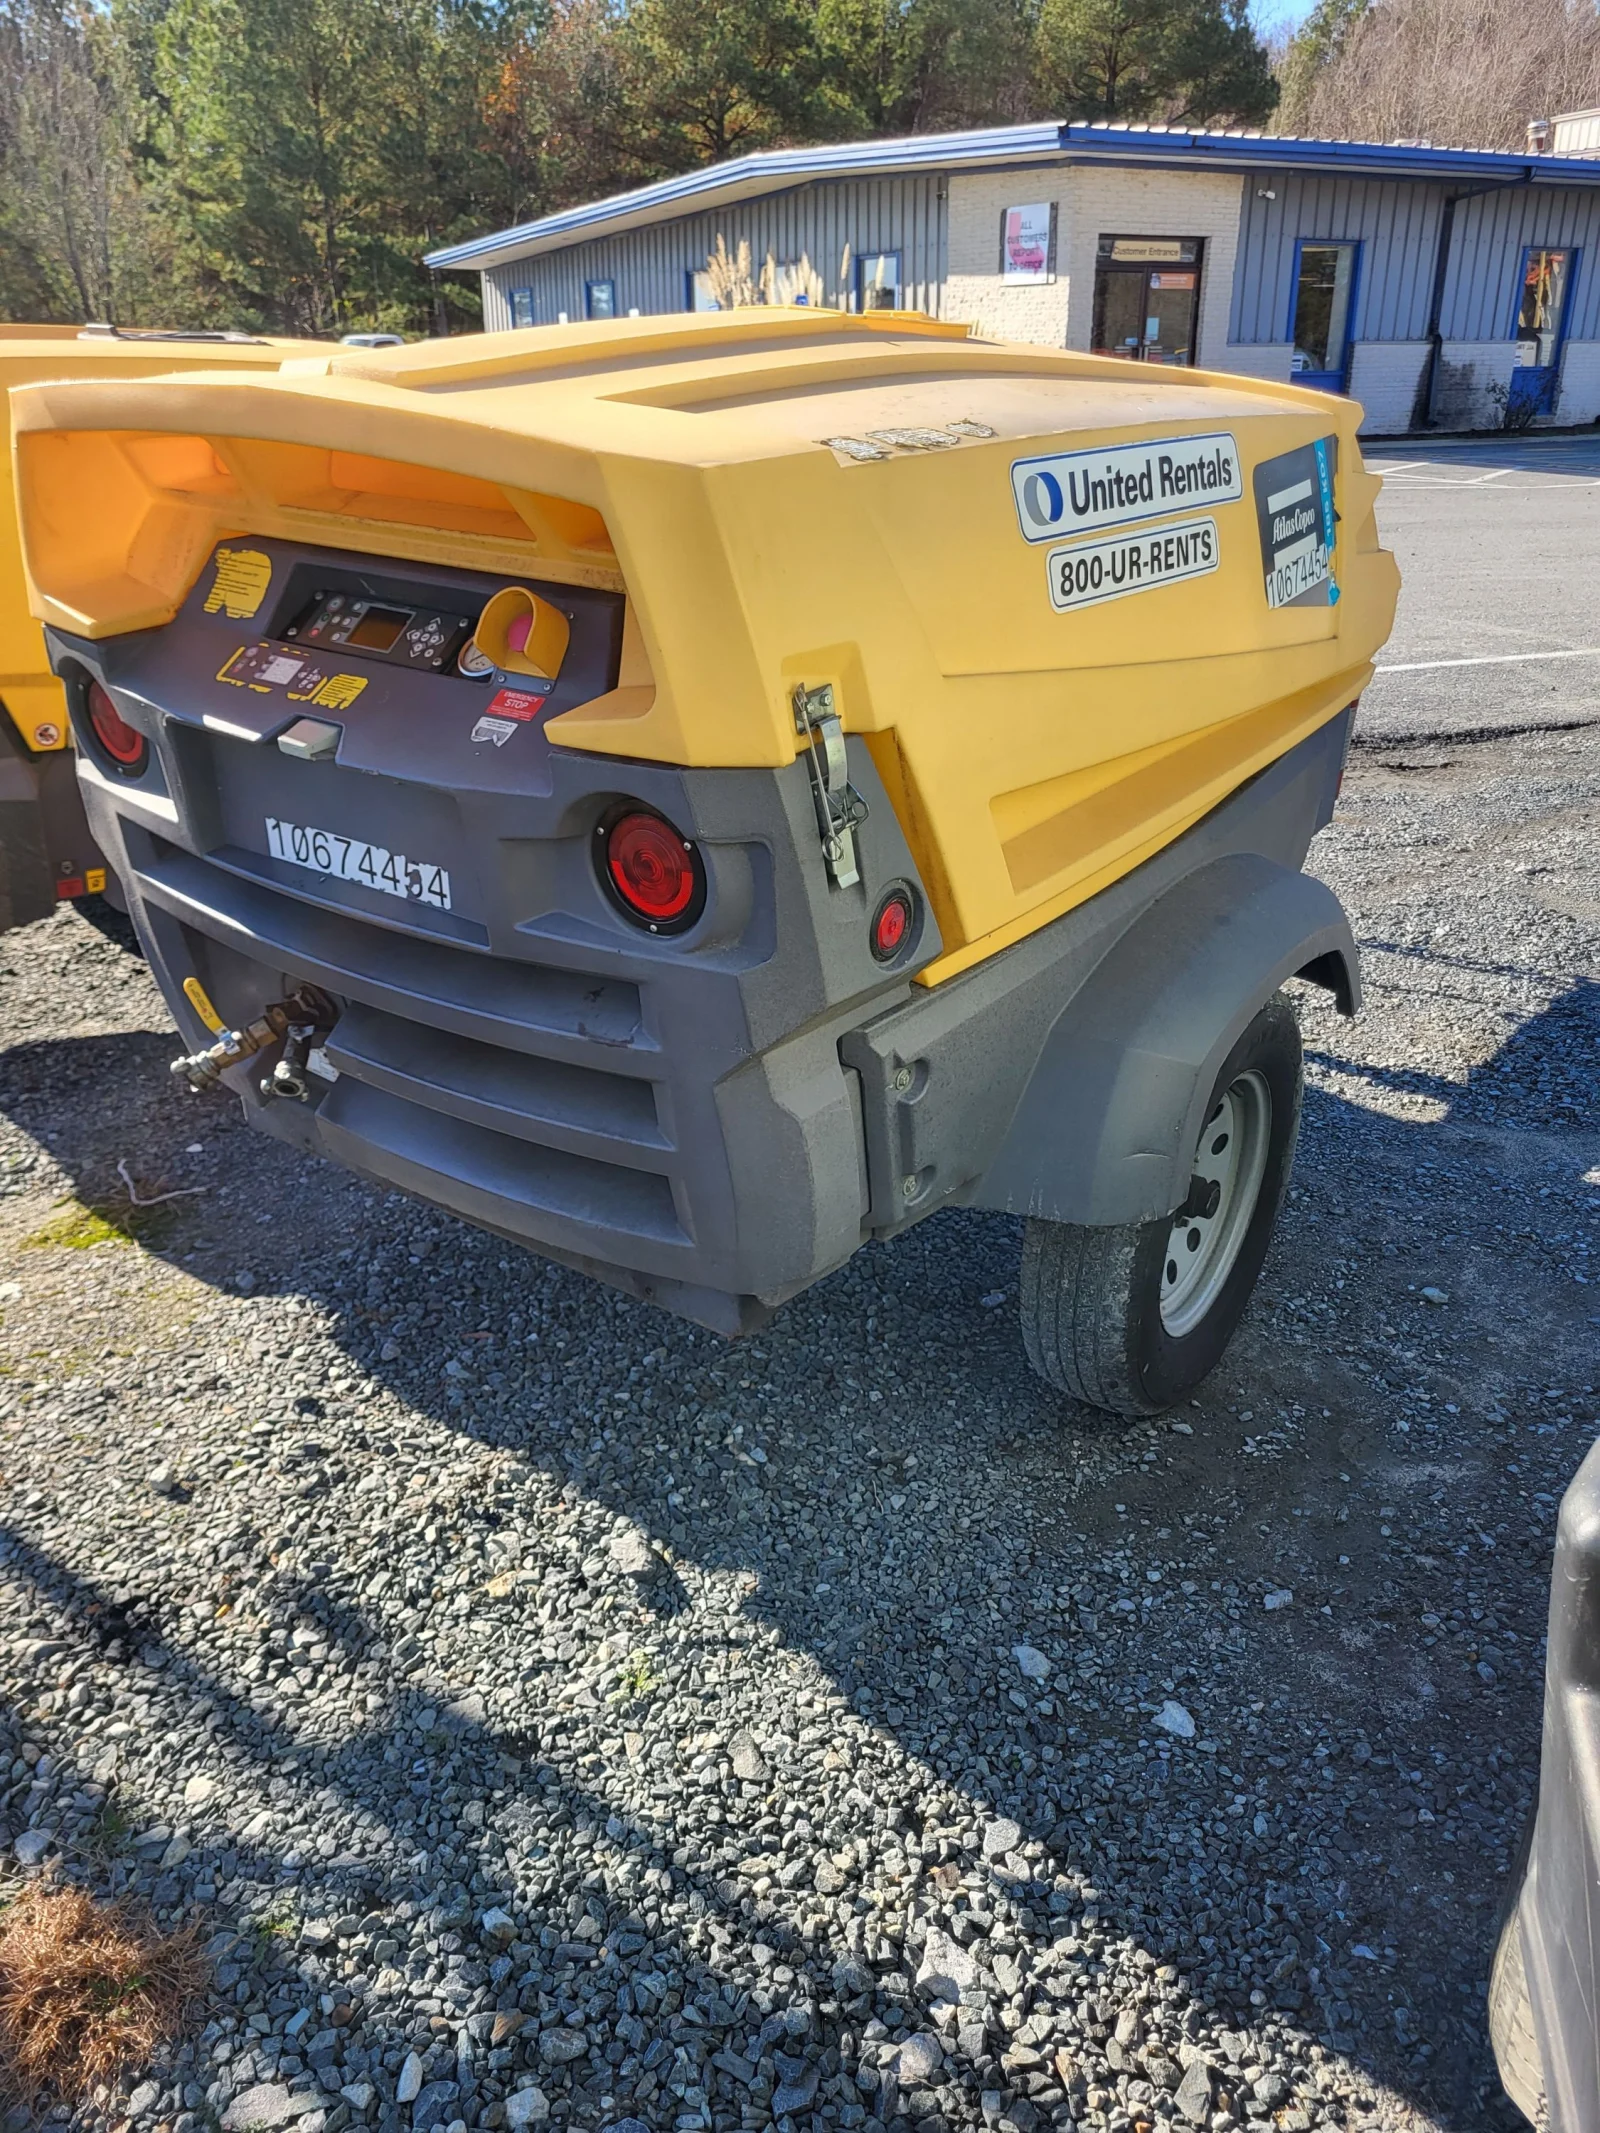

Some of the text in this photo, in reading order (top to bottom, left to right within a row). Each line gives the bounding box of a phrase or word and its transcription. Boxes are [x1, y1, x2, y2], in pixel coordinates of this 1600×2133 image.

[1020, 220, 1033, 230] ALL
[1007, 232, 1048, 244] CUSTOMERS
[1012, 247, 1040, 257] REPORT
[1113, 246, 1179, 257] Customer Entrance
[1009, 259, 1043, 271] TO OFFICE
[1068, 448, 1232, 516] United Rentals
[1060, 529, 1212, 597] 800-UR-RENTS
[1268, 544, 1328, 607] 10674454
[504, 691, 538, 702] EMERGENCY
[504, 699, 529, 709] STOP
[271, 821, 448, 907] 10674454
